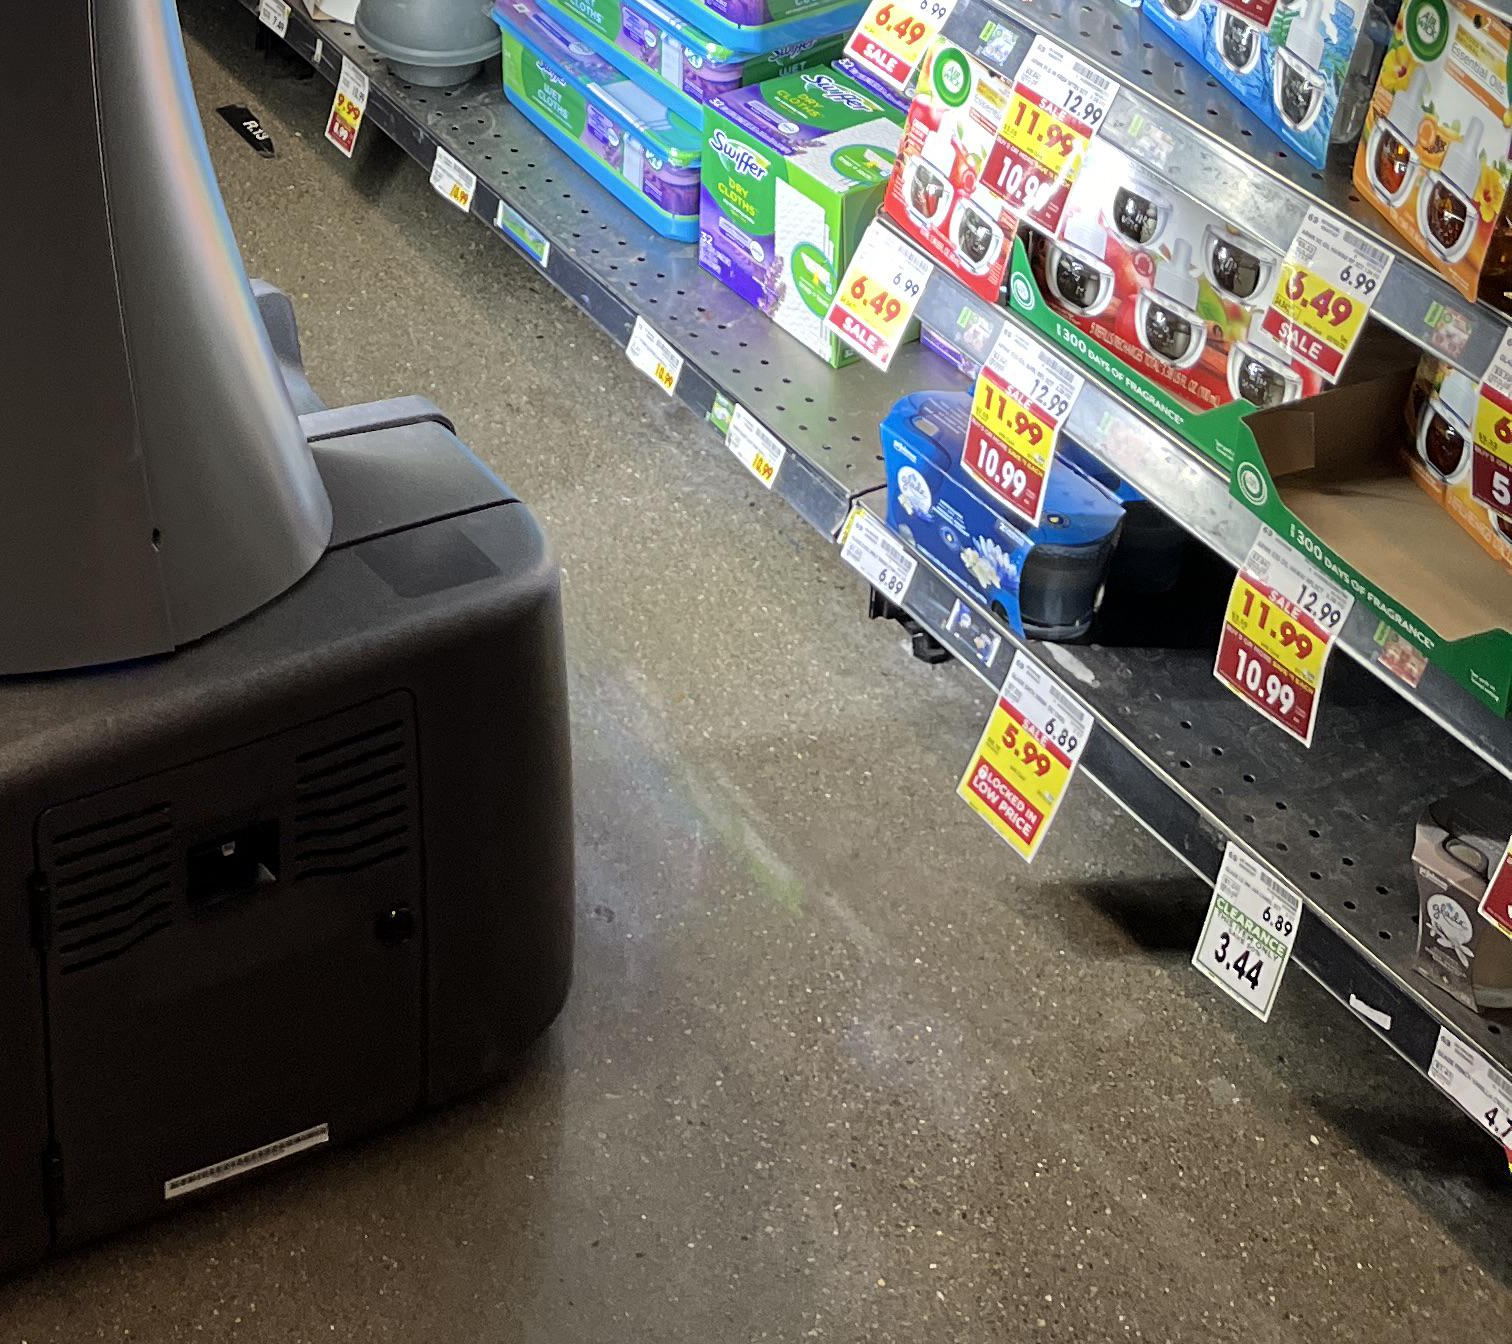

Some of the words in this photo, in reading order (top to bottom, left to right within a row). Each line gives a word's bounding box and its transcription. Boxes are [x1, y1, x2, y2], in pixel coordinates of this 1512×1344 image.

[874, 4, 926, 48] 6.49
[863, 44, 898, 75] SALE
[1451, 44, 1488, 82] Essential
[1489, 72, 1506, 98] Oils
[800, 72, 874, 113] Swiffer
[1063, 89, 1104, 126] 12.99
[1015, 100, 1076, 158] 11.99
[708, 127, 768, 182] Swiffer
[717, 182, 758, 220] CLOTHS
[848, 275, 902, 324] 6.49
[892, 270, 921, 297] 6.99
[1285, 271, 1354, 327] 6.49
[1339, 265, 1377, 296] 6.99
[841, 314, 881, 351] SALE
[1278, 322, 1323, 361] SALE
[984, 386, 1044, 446] 11.99
[1031, 378, 1069, 417] 12.99
[977, 440, 1028, 498] 10.99
[878, 568, 906, 596] 6.89
[1242, 587, 1313, 660] 11.99
[1295, 583, 1342, 630] 12.99
[1234, 648, 1297, 716] 10.99
[1000, 723, 1052, 779] 5.99
[1021, 718, 1050, 747] SALE
[1045, 719, 1079, 755] 6.89
[971, 774, 999, 806] LOW
[997, 794, 1034, 838] PRICE
[986, 772, 1025, 812] LOCKED
[1024, 806, 1039, 825] IN
[1215, 896, 1287, 955] CLEARANCE
[1261, 906, 1293, 937] 6.89
[1214, 932, 1264, 991] 3.44
